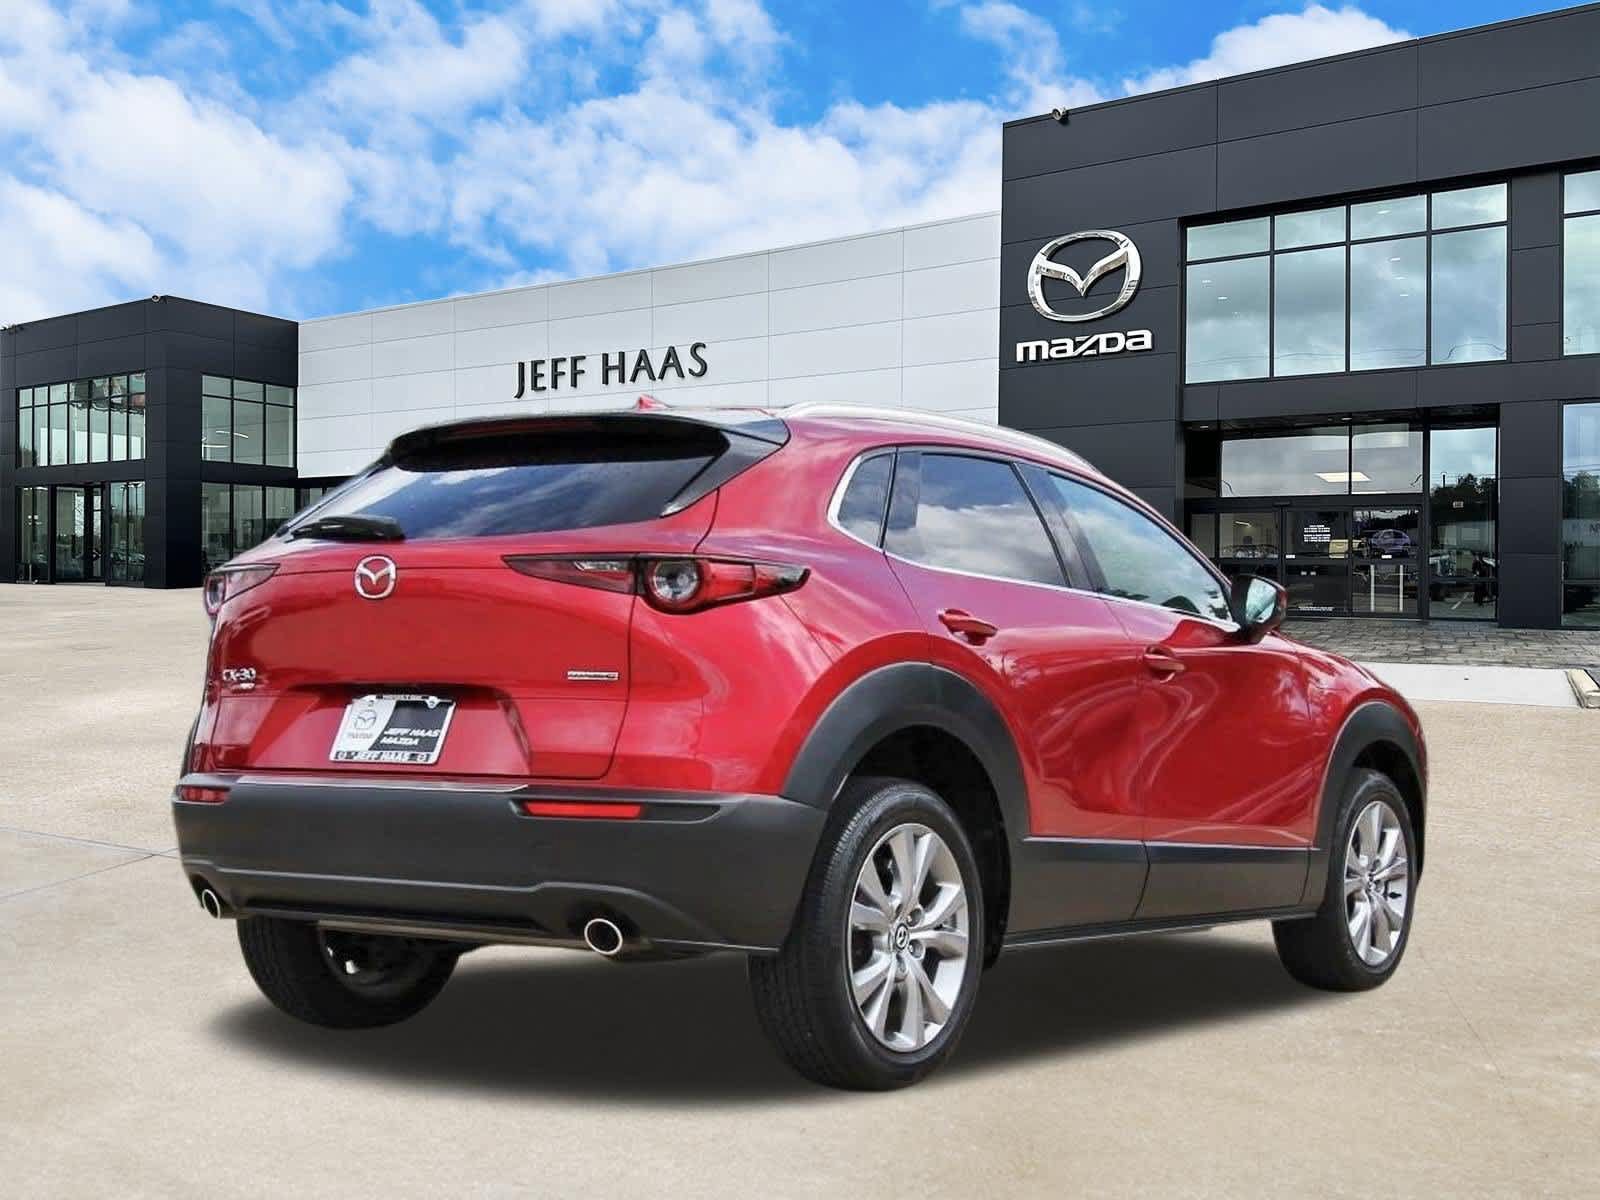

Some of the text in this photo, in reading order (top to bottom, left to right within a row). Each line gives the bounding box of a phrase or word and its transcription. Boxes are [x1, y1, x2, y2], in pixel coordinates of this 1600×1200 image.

[514, 342, 708, 399] JEFF HAAS
[222, 667, 257, 681] CX-30
